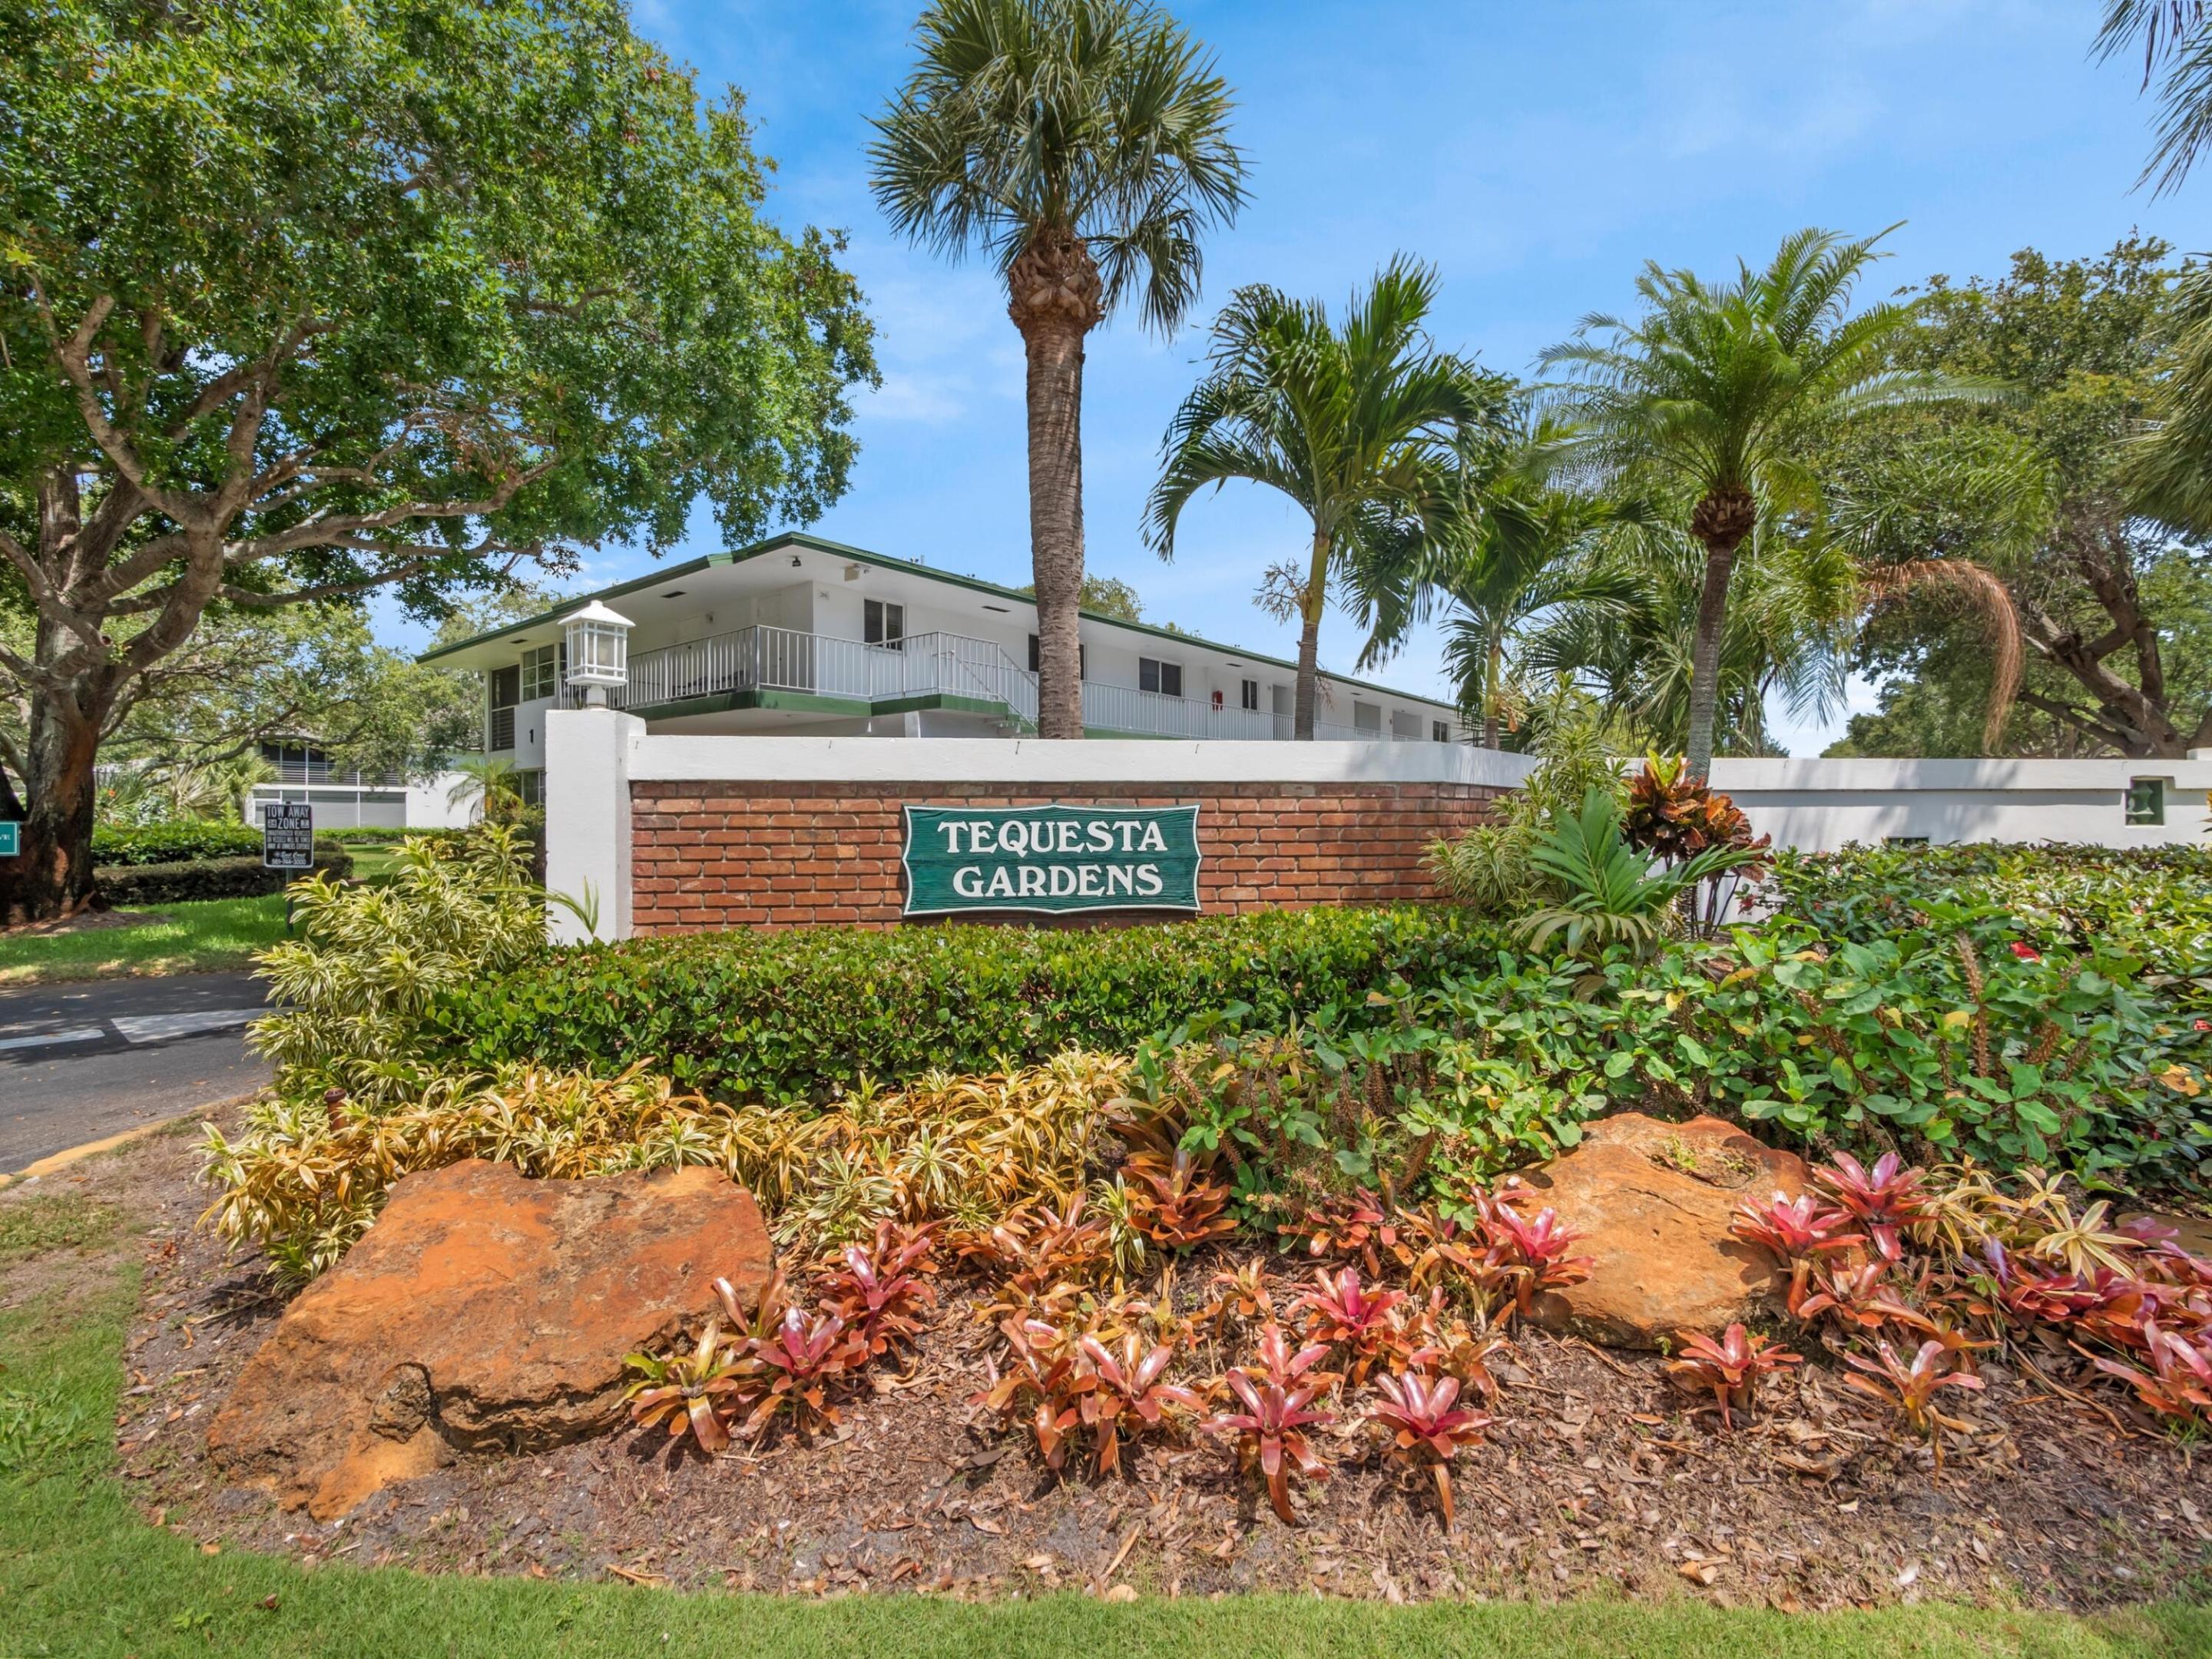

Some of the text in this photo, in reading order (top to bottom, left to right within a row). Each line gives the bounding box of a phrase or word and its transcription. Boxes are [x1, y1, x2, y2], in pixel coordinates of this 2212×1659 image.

[267, 806, 309, 818] TOW AWAY
[278, 818, 300, 830] ZONE
[938, 820, 1167, 858] TEQUESTA
[952, 863, 1163, 897] GARDENS
